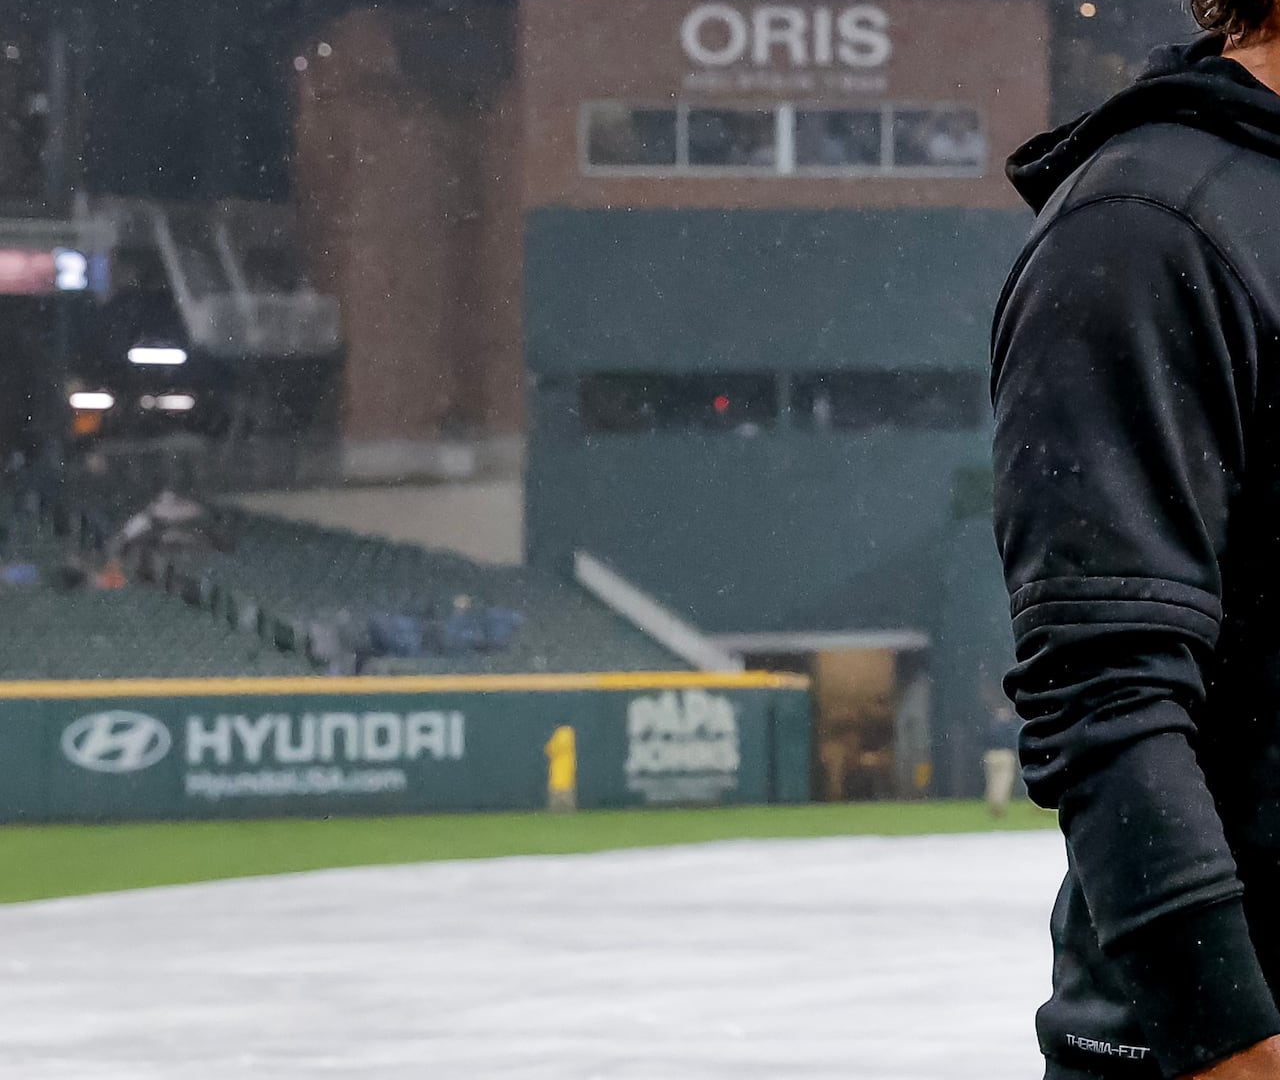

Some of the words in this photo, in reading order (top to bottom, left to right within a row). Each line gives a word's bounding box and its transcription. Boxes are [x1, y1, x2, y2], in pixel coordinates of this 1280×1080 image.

[680, 3, 892, 67] ORIS
[185, 710, 466, 764] HYUNDAI
[1066, 1033, 1150, 1060] THERMA-FIT
